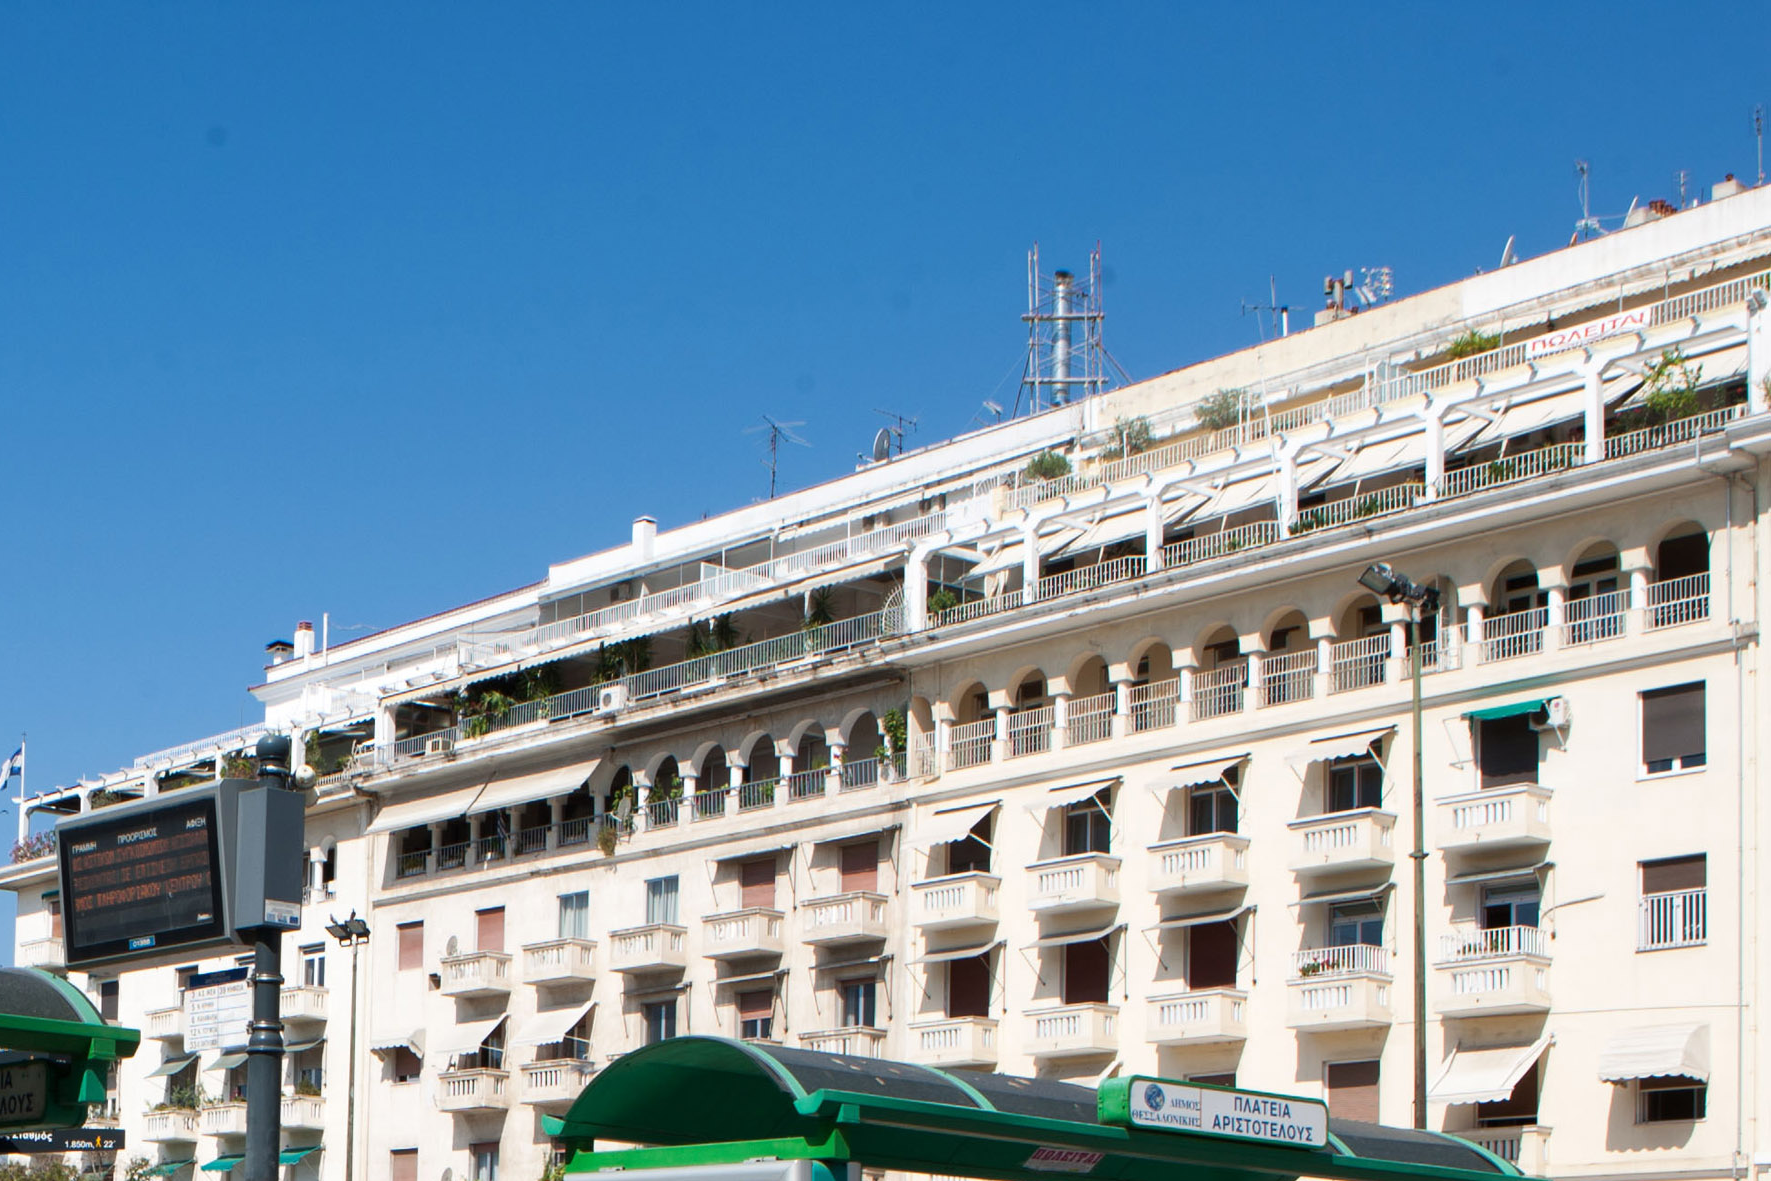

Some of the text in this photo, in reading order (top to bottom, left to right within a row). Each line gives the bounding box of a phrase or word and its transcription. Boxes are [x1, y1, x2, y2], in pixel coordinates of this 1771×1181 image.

[1531, 312, 1644, 351] ΠΩΛΕΙΤΑΙ
[1170, 1099, 1201, 1111] ΔΗΜΟΣ
[1234, 1096, 1291, 1118] ΠΛΑΤΕΙΑ
[1132, 1110, 1201, 1128] ΘΕΣΣΑΛΟΝΙΚΗΣ
[1212, 1114, 1313, 1142] ΑΡΙΣΤΟΤΕΛΟΥΣ
[1032, 1148, 1103, 1165] ΠΩΛΕΙΤΑΙ
